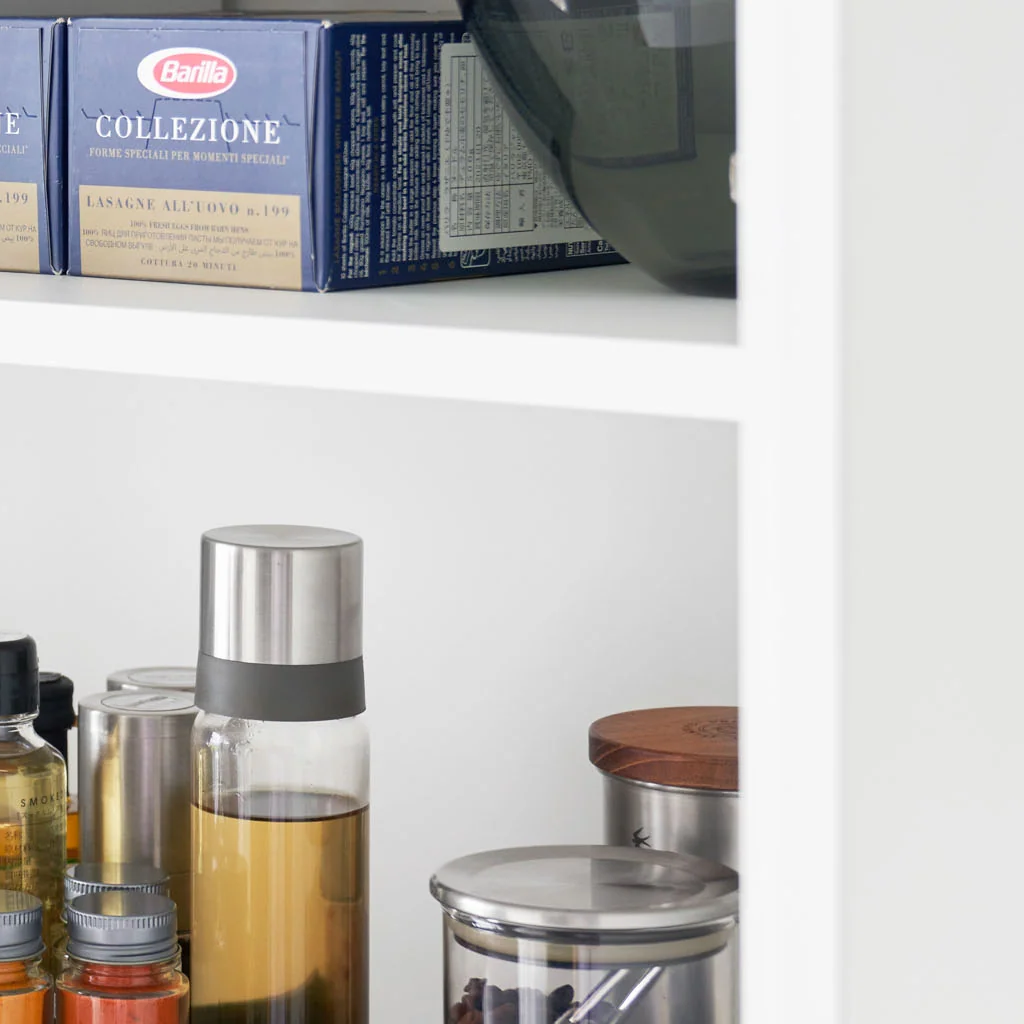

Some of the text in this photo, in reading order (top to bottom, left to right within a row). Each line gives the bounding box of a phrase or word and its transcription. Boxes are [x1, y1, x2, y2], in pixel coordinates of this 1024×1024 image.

[160, 60, 228, 84] Barilla
[95, 114, 281, 145] COLLEZIONE
[89, 147, 123, 158] FORME
[124, 148, 168, 160] SPECIALI
[171, 150, 190, 161] PER
[192, 151, 238, 164] MOMENTI
[87, 195, 156, 211] LASAGNE
[246, 204, 291, 218] n.199
